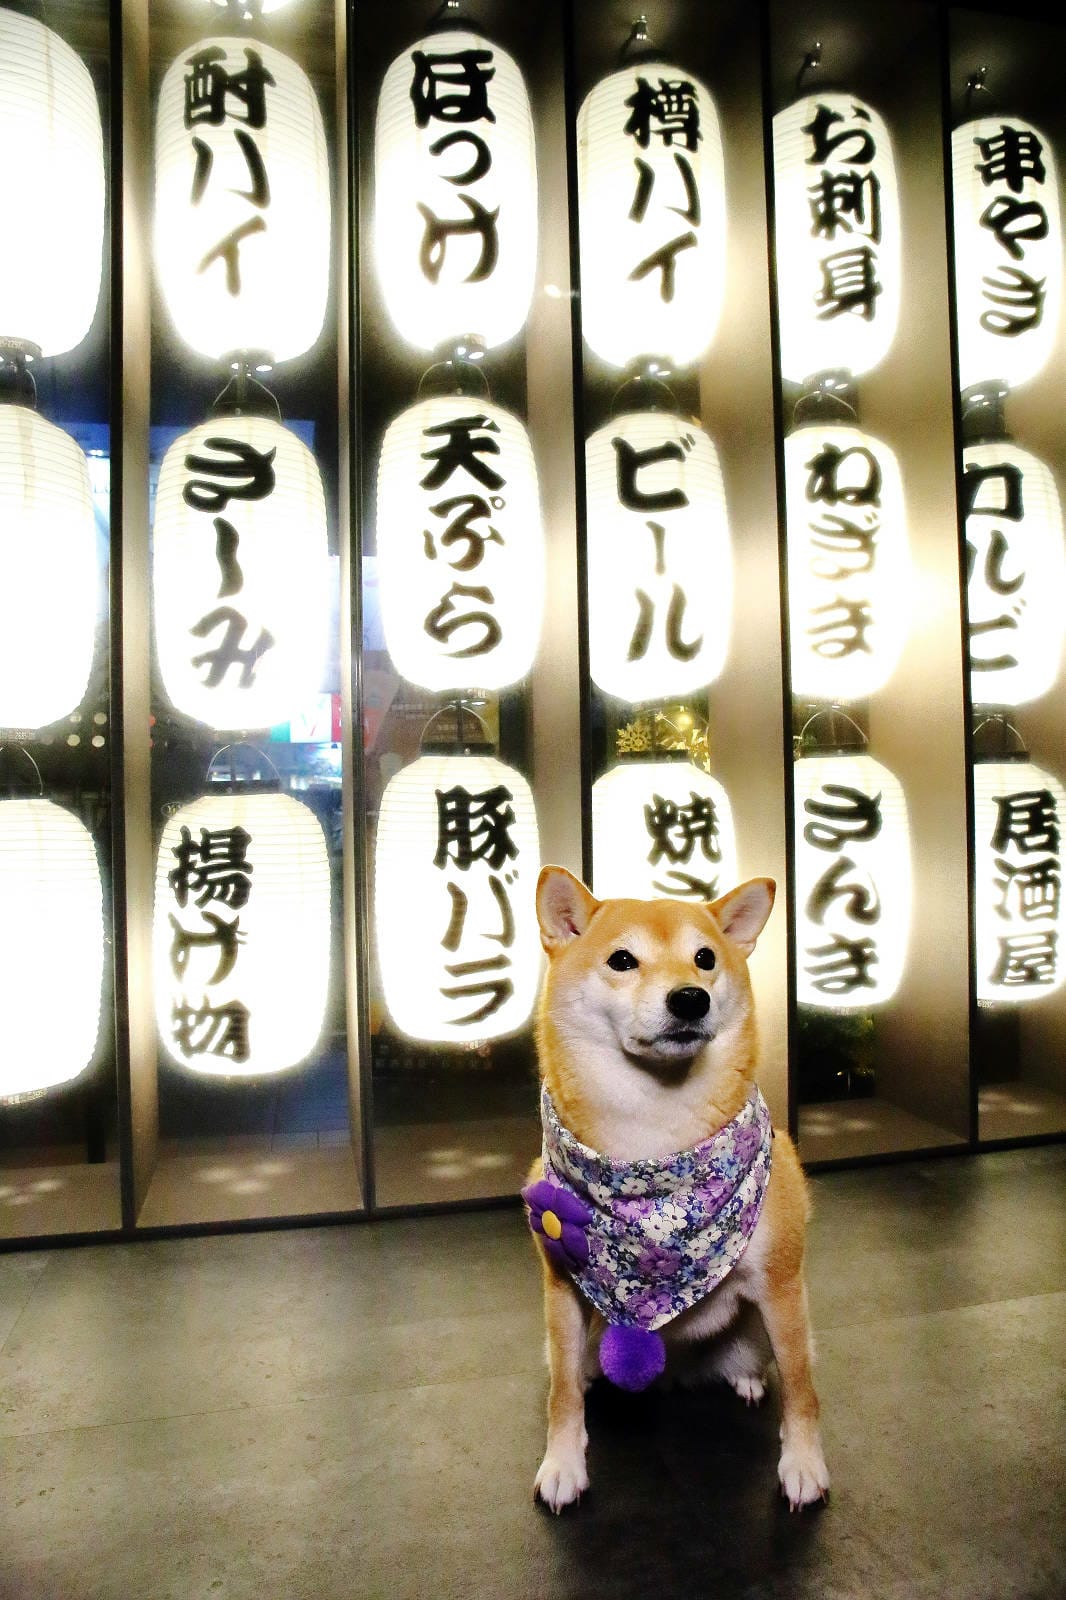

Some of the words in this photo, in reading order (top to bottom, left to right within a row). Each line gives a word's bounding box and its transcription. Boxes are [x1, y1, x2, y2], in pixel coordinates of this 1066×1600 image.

[184, 45, 277, 298] 酎ハイ
[624, 76, 703, 304] 樽ハイ
[800, 103, 882, 322] お刺身
[973, 125, 1049, 337] 串やき
[419, 414, 506, 658] 天ぷら
[611, 433, 704, 663] ビール
[803, 442, 882, 659] ねぎま
[168, 825, 254, 1064] 揚げ物
[433, 784, 520, 1026] 豚バラ
[803, 784, 882, 995] さんま
[989, 788, 1062, 987] 居酒屋
